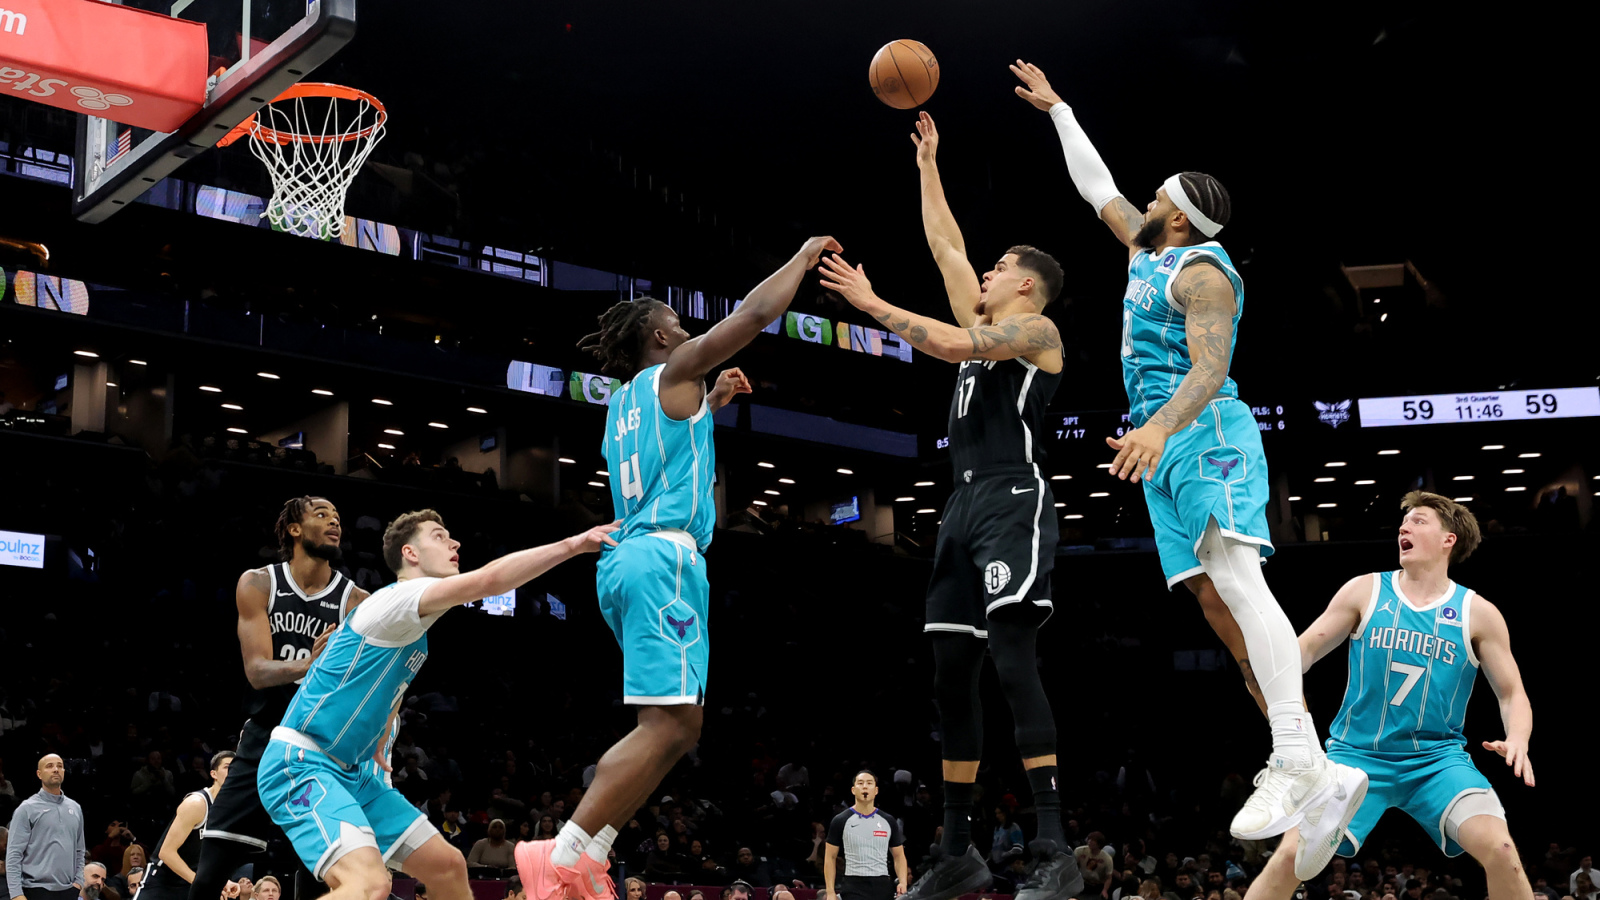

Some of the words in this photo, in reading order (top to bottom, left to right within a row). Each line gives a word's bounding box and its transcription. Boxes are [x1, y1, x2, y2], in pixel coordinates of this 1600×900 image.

[958, 375, 976, 419] 17
[1470, 395, 1500, 403] Quarter
[1526, 393, 1558, 415] 59
[1276, 405, 1284, 415] 0
[1402, 400, 1435, 421] 59
[1455, 404, 1504, 420] 11:46
[614, 407, 642, 442] JAES
[1063, 416, 1079, 426] 3PT
[1277, 420, 1285, 430] 6
[1056, 430, 1063, 439] 7
[1073, 429, 1086, 439] 17
[1116, 427, 1124, 437] 6
[620, 451, 645, 502] 4
[1369, 626, 1458, 666] HORNETS
[1389, 660, 1428, 707] 7
